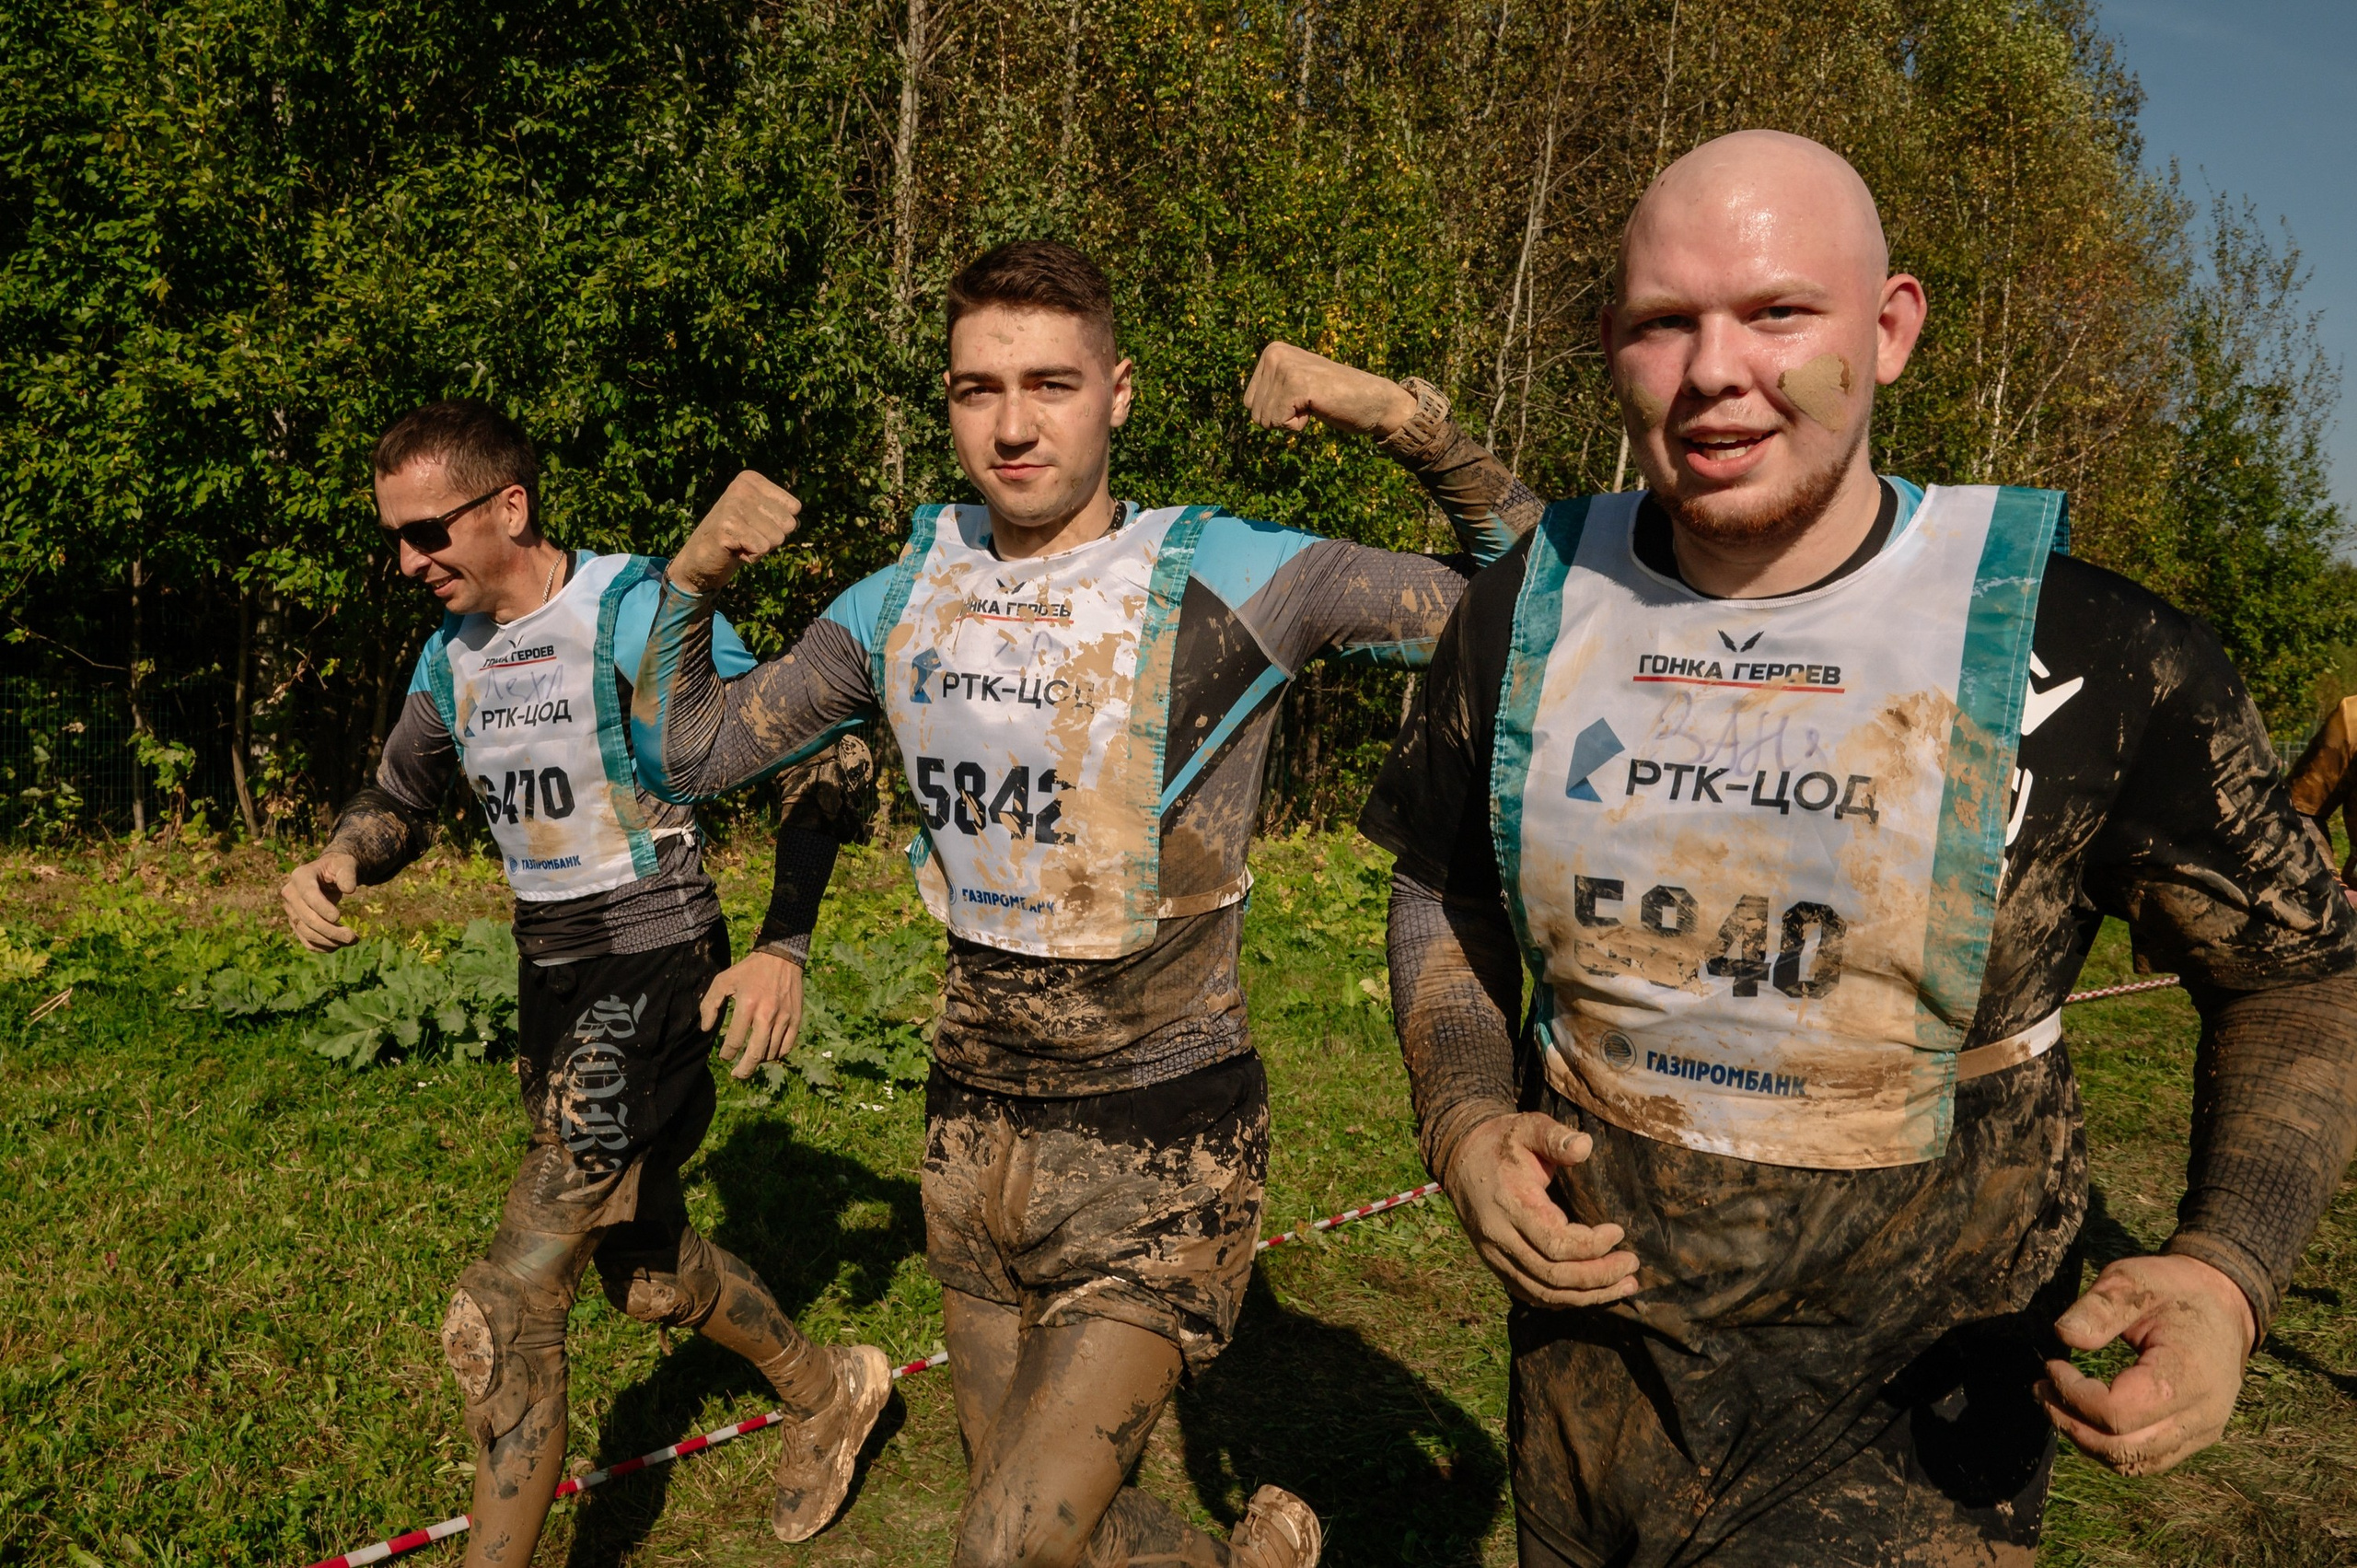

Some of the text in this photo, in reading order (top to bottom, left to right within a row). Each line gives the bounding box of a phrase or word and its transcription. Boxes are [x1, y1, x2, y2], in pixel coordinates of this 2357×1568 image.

[511, 645, 554, 662] ГЕРОЕВ
[1639, 655, 1841, 685] ГОНКА ГЕРОЕВ
[482, 699, 572, 730] РТК-ЦОД
[478, 766, 576, 825] 6470
[916, 757, 1077, 846] 5842
[1626, 759, 1880, 824] РТК-ЦОД
[520, 855, 582, 870] ГАЗПРОМБАНК
[1646, 1050, 1808, 1098] ГАЗПРОМБАНК
